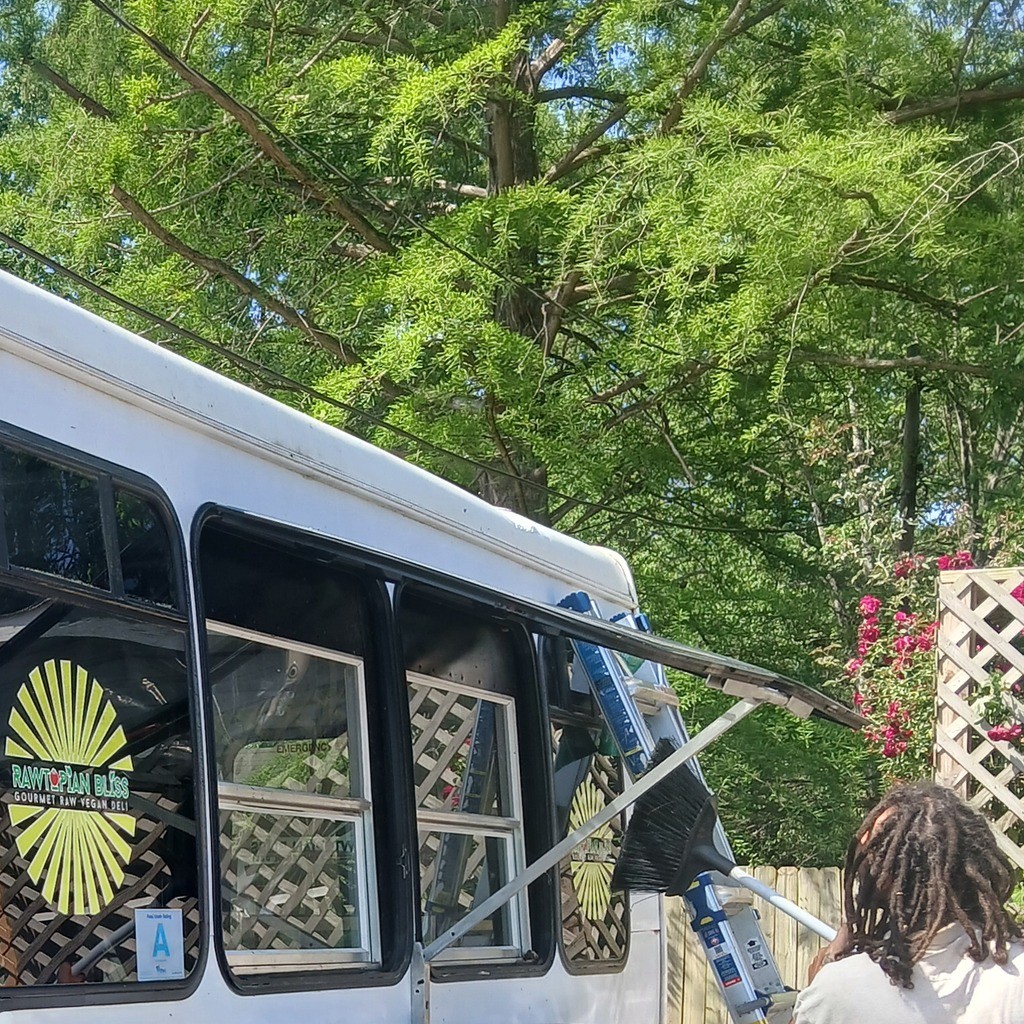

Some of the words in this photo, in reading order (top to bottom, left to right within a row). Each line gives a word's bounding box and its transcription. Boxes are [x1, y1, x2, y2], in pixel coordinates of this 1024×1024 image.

[11, 764, 91, 796] RAWTOPIAN
[93, 770, 130, 799] BLISS
[14, 791, 56, 805] GOURMET
[59, 795, 77, 807] RAW
[80, 797, 108, 810] VEGAN
[111, 801, 129, 811] DELI
[152, 922, 171, 958] A
